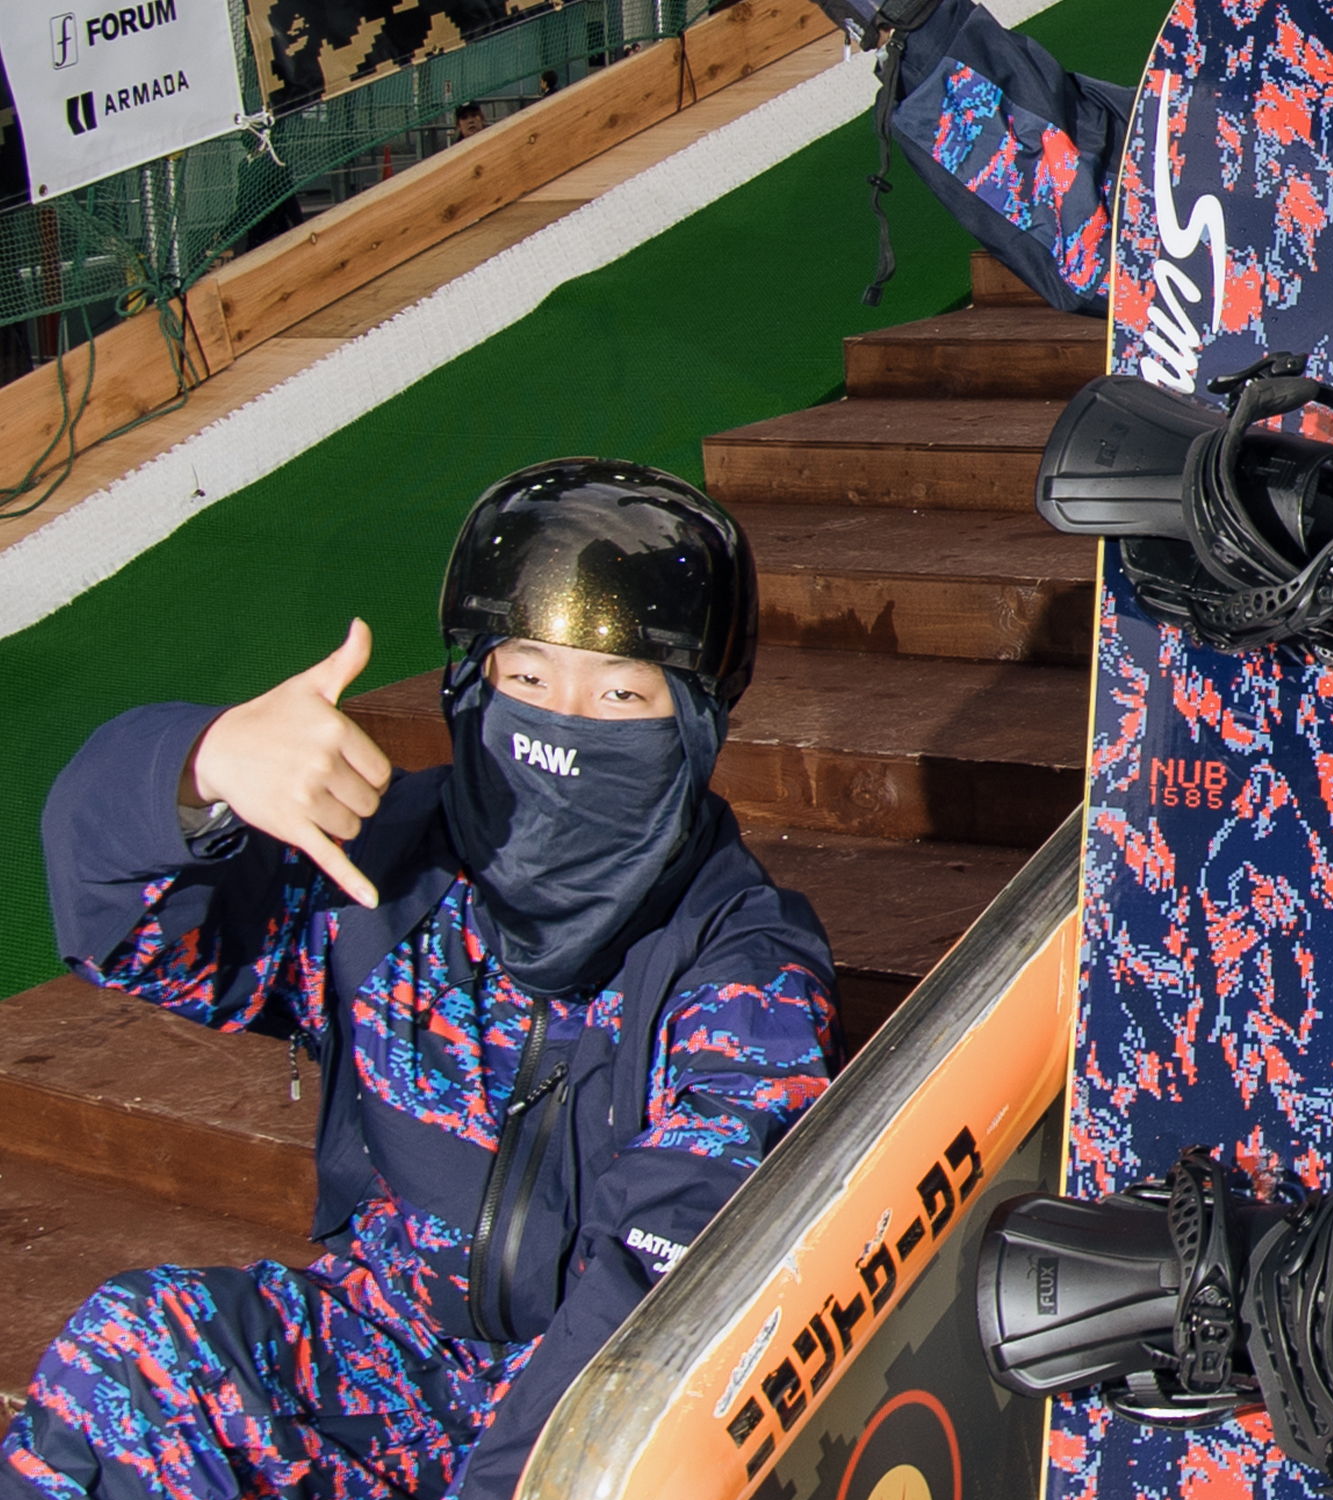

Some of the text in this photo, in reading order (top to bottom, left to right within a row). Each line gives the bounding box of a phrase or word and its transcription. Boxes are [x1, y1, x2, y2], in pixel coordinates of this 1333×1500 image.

[105, 70, 190, 117] ARMADA
[512, 732, 580, 779] PAW.
[1150, 758, 1228, 790] NUB
[1149, 788, 1225, 809] 1585
[1039, 1264, 1056, 1309] FLUX
